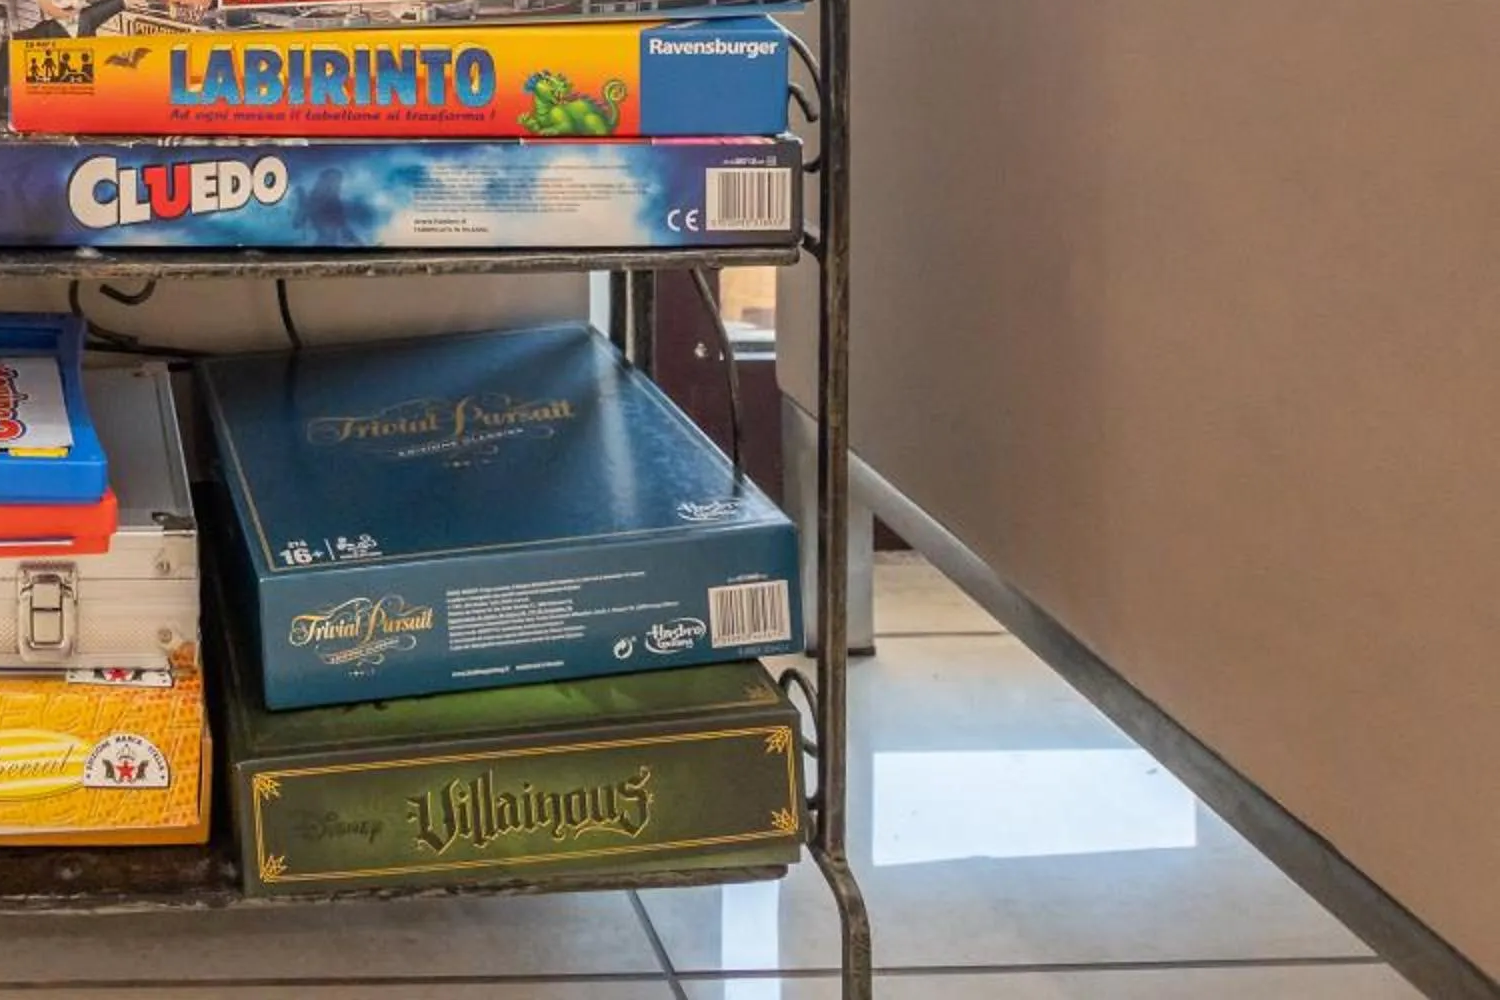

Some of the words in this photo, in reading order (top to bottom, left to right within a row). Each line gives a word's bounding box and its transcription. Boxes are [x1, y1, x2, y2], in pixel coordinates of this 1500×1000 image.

[170, 42, 497, 109] LABIRINTO
[649, 38, 779, 59] Ravensburger
[69, 155, 288, 229] CLUEDO
[289, 601, 361, 646] Trivial
[406, 765, 653, 856] Villainous
